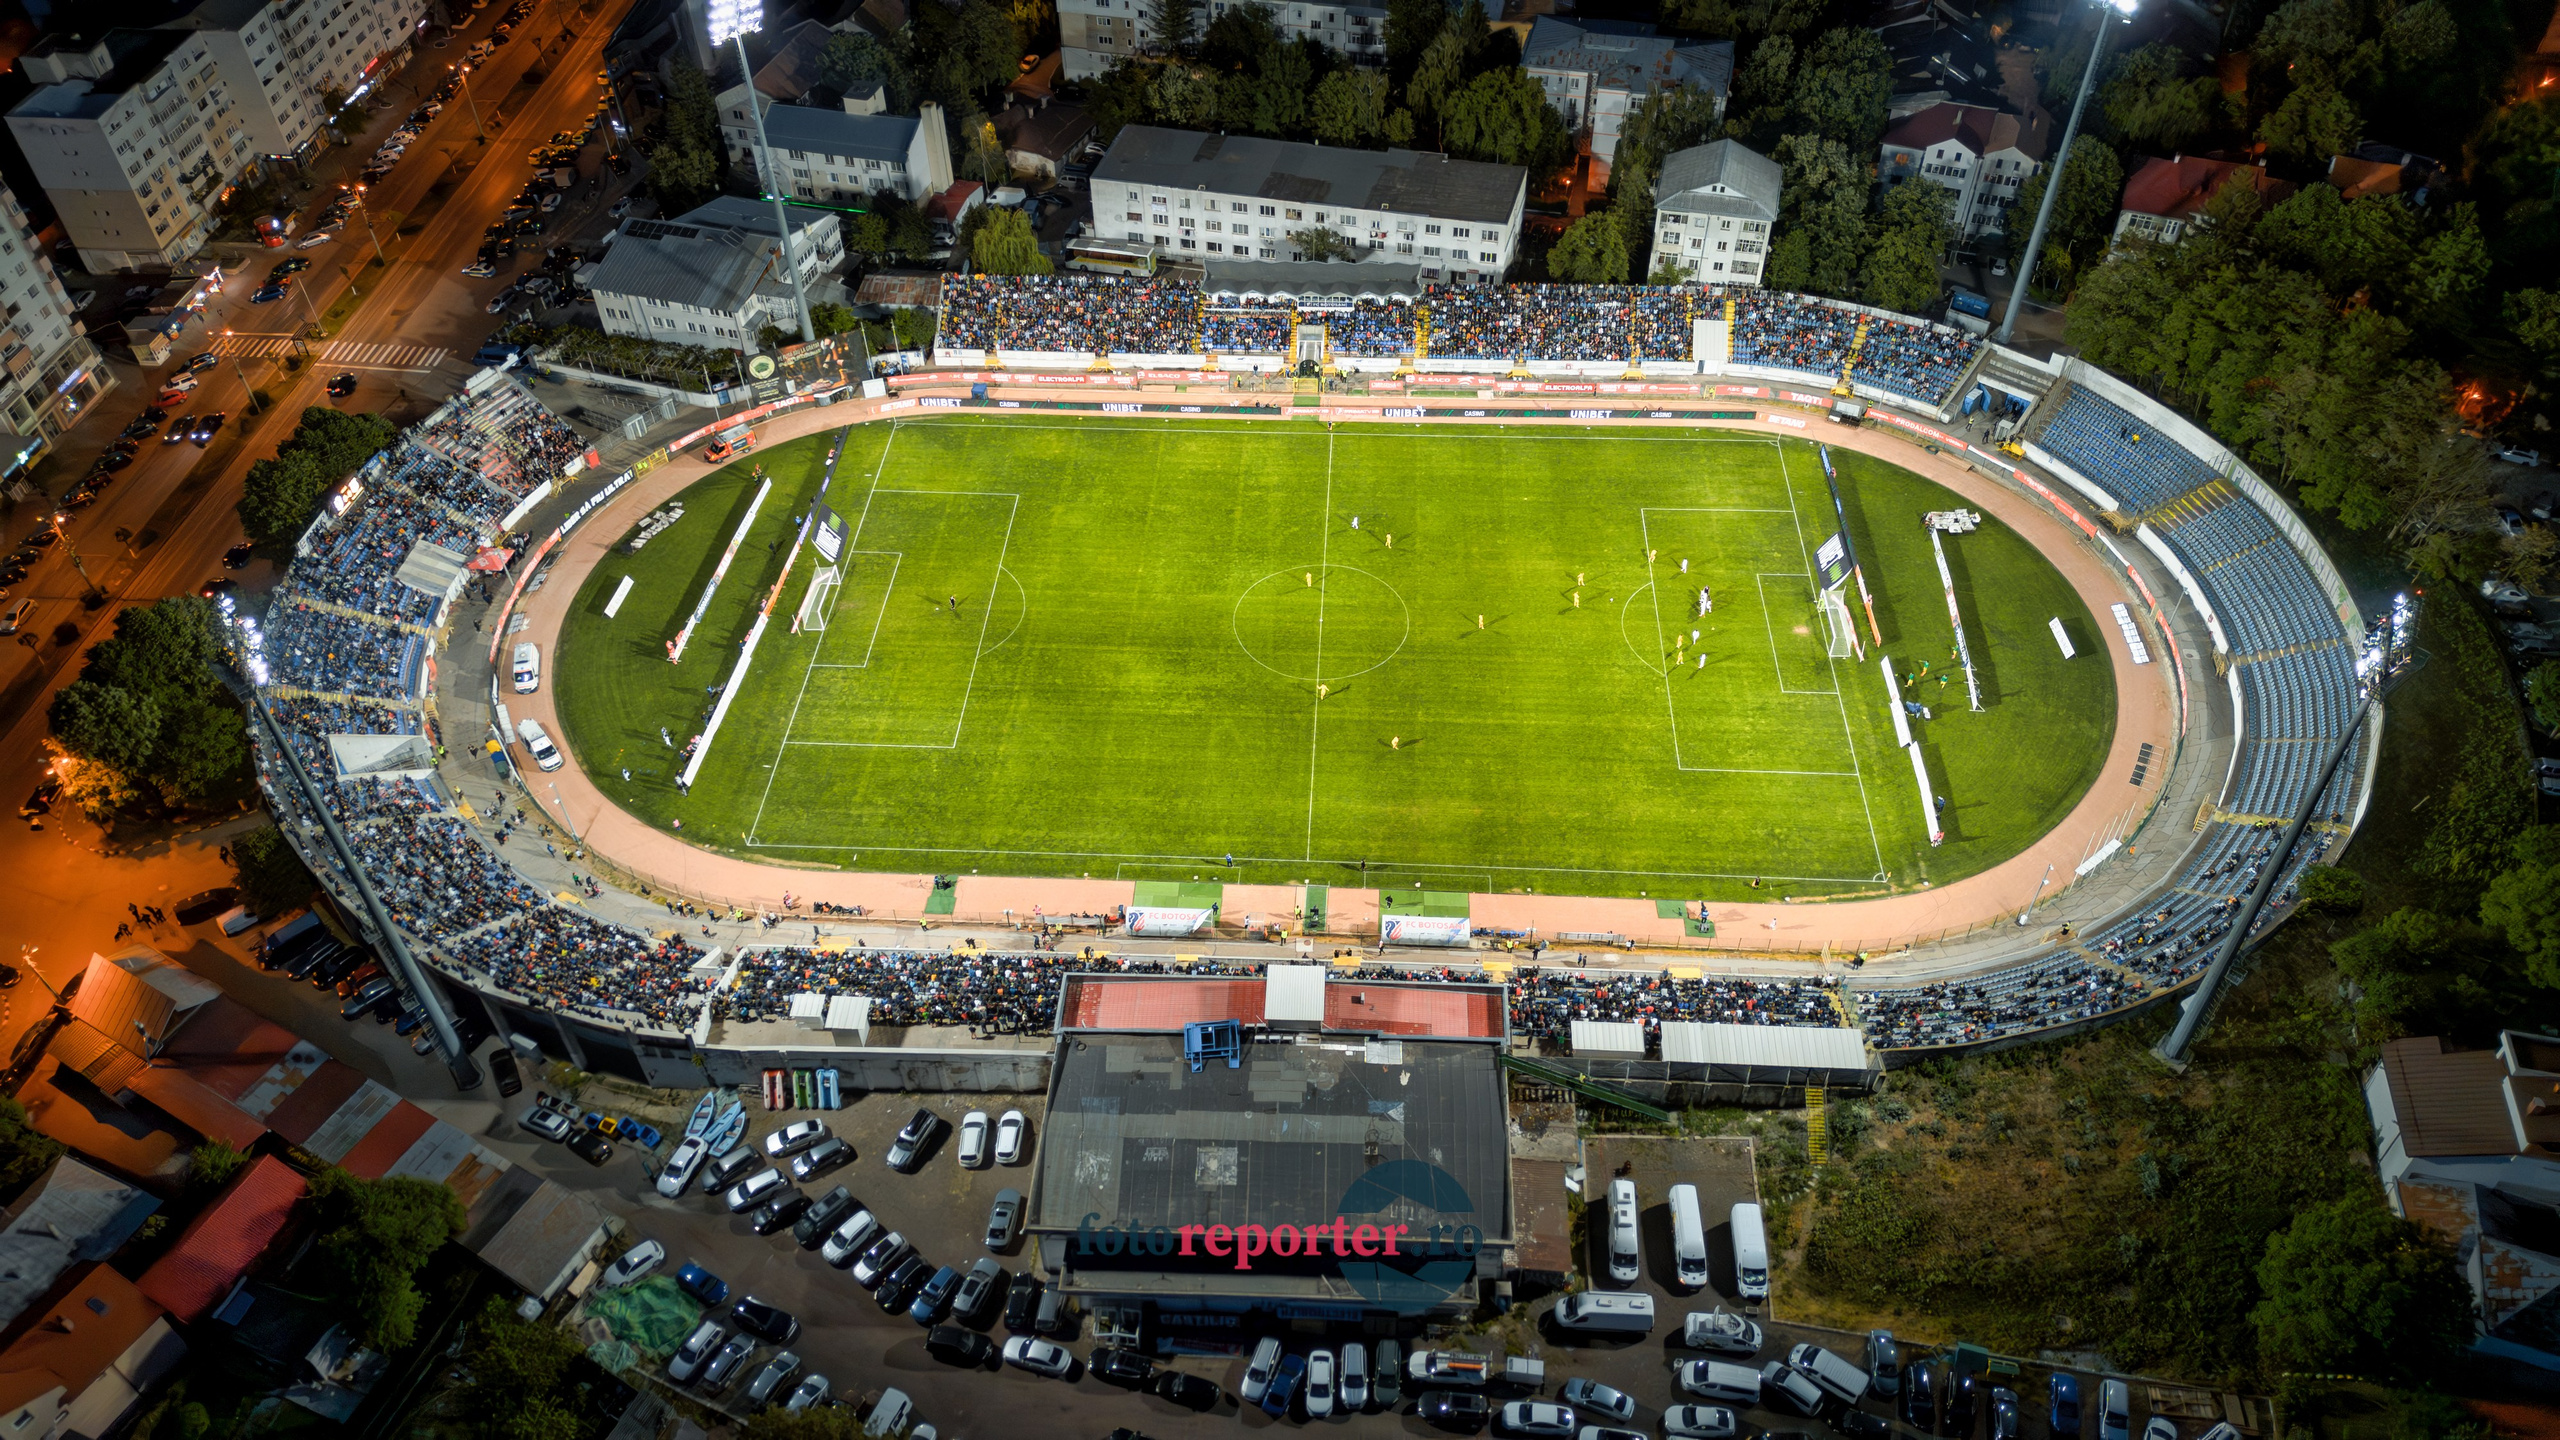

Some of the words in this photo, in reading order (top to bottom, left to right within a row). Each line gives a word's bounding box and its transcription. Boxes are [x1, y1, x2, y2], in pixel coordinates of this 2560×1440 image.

[880, 399, 916, 413] BETANO
[921, 398, 962, 408] UNIBET
[1102, 403, 1143, 413] UNIBET
[1385, 408, 1426, 417] UNIBET
[1570, 410, 1613, 419] UNIBET
[1650, 411, 1672, 419] CASINO
[1767, 414, 1806, 429] BETANO
[1895, 416, 1940, 440] PRODALCOM
[560, 510, 582, 535] LIBER
[590, 491, 606, 509] FIU
[694, 584, 716, 615] PRODALCOM
[1148, 912, 1159, 920] FC
[1405, 920, 1417, 929] FC
[1418, 921, 1466, 930] BOTOSANI
